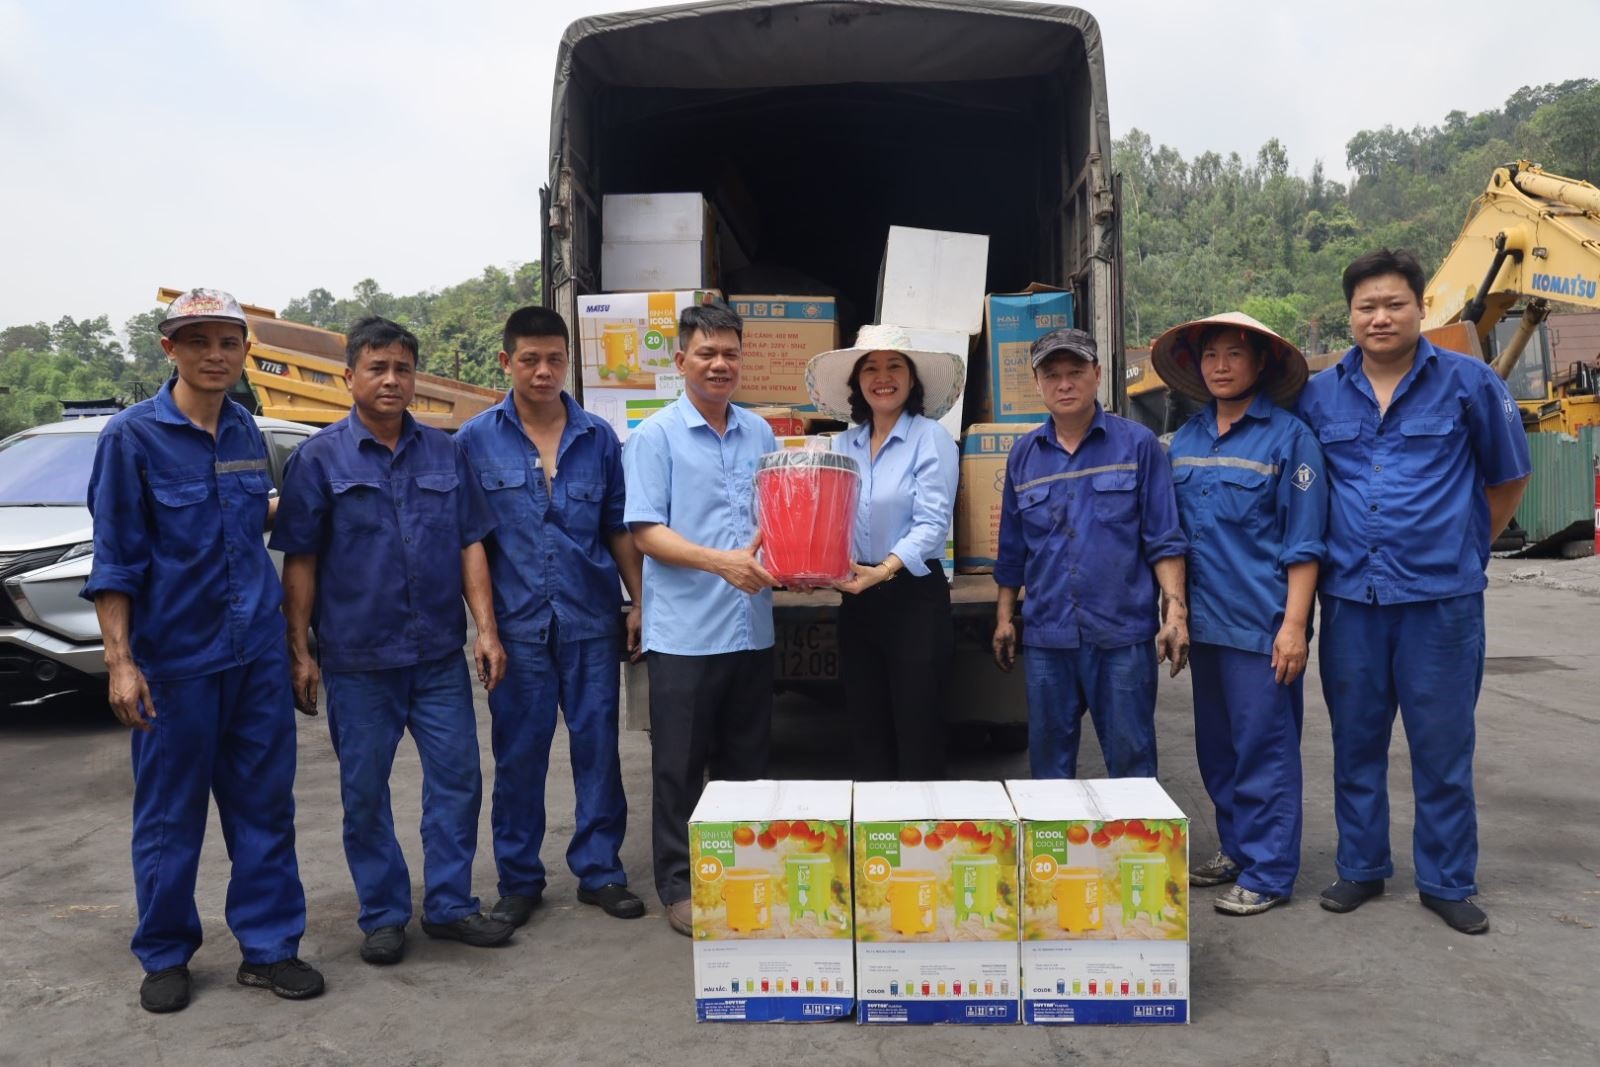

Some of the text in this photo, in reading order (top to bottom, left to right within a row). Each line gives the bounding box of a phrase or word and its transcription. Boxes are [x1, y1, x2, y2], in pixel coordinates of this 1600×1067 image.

[1532, 273, 1597, 299] KOMATSU
[586, 304, 610, 313] MATSU
[649, 317, 674, 325] ICOOL
[647, 336, 660, 345] 20
[261, 360, 283, 374] 777E
[1126, 367, 1139, 379] LVO
[869, 832, 897, 841] ICOOL
[1035, 831, 1064, 839] ICOOL
[702, 840, 733, 849] ICOOL
[869, 842, 898, 850] COOLER
[1035, 840, 1064, 848] COOLER
[701, 863, 717, 874] 20
[869, 864, 885, 875] 20
[1035, 862, 1052, 873] 20
